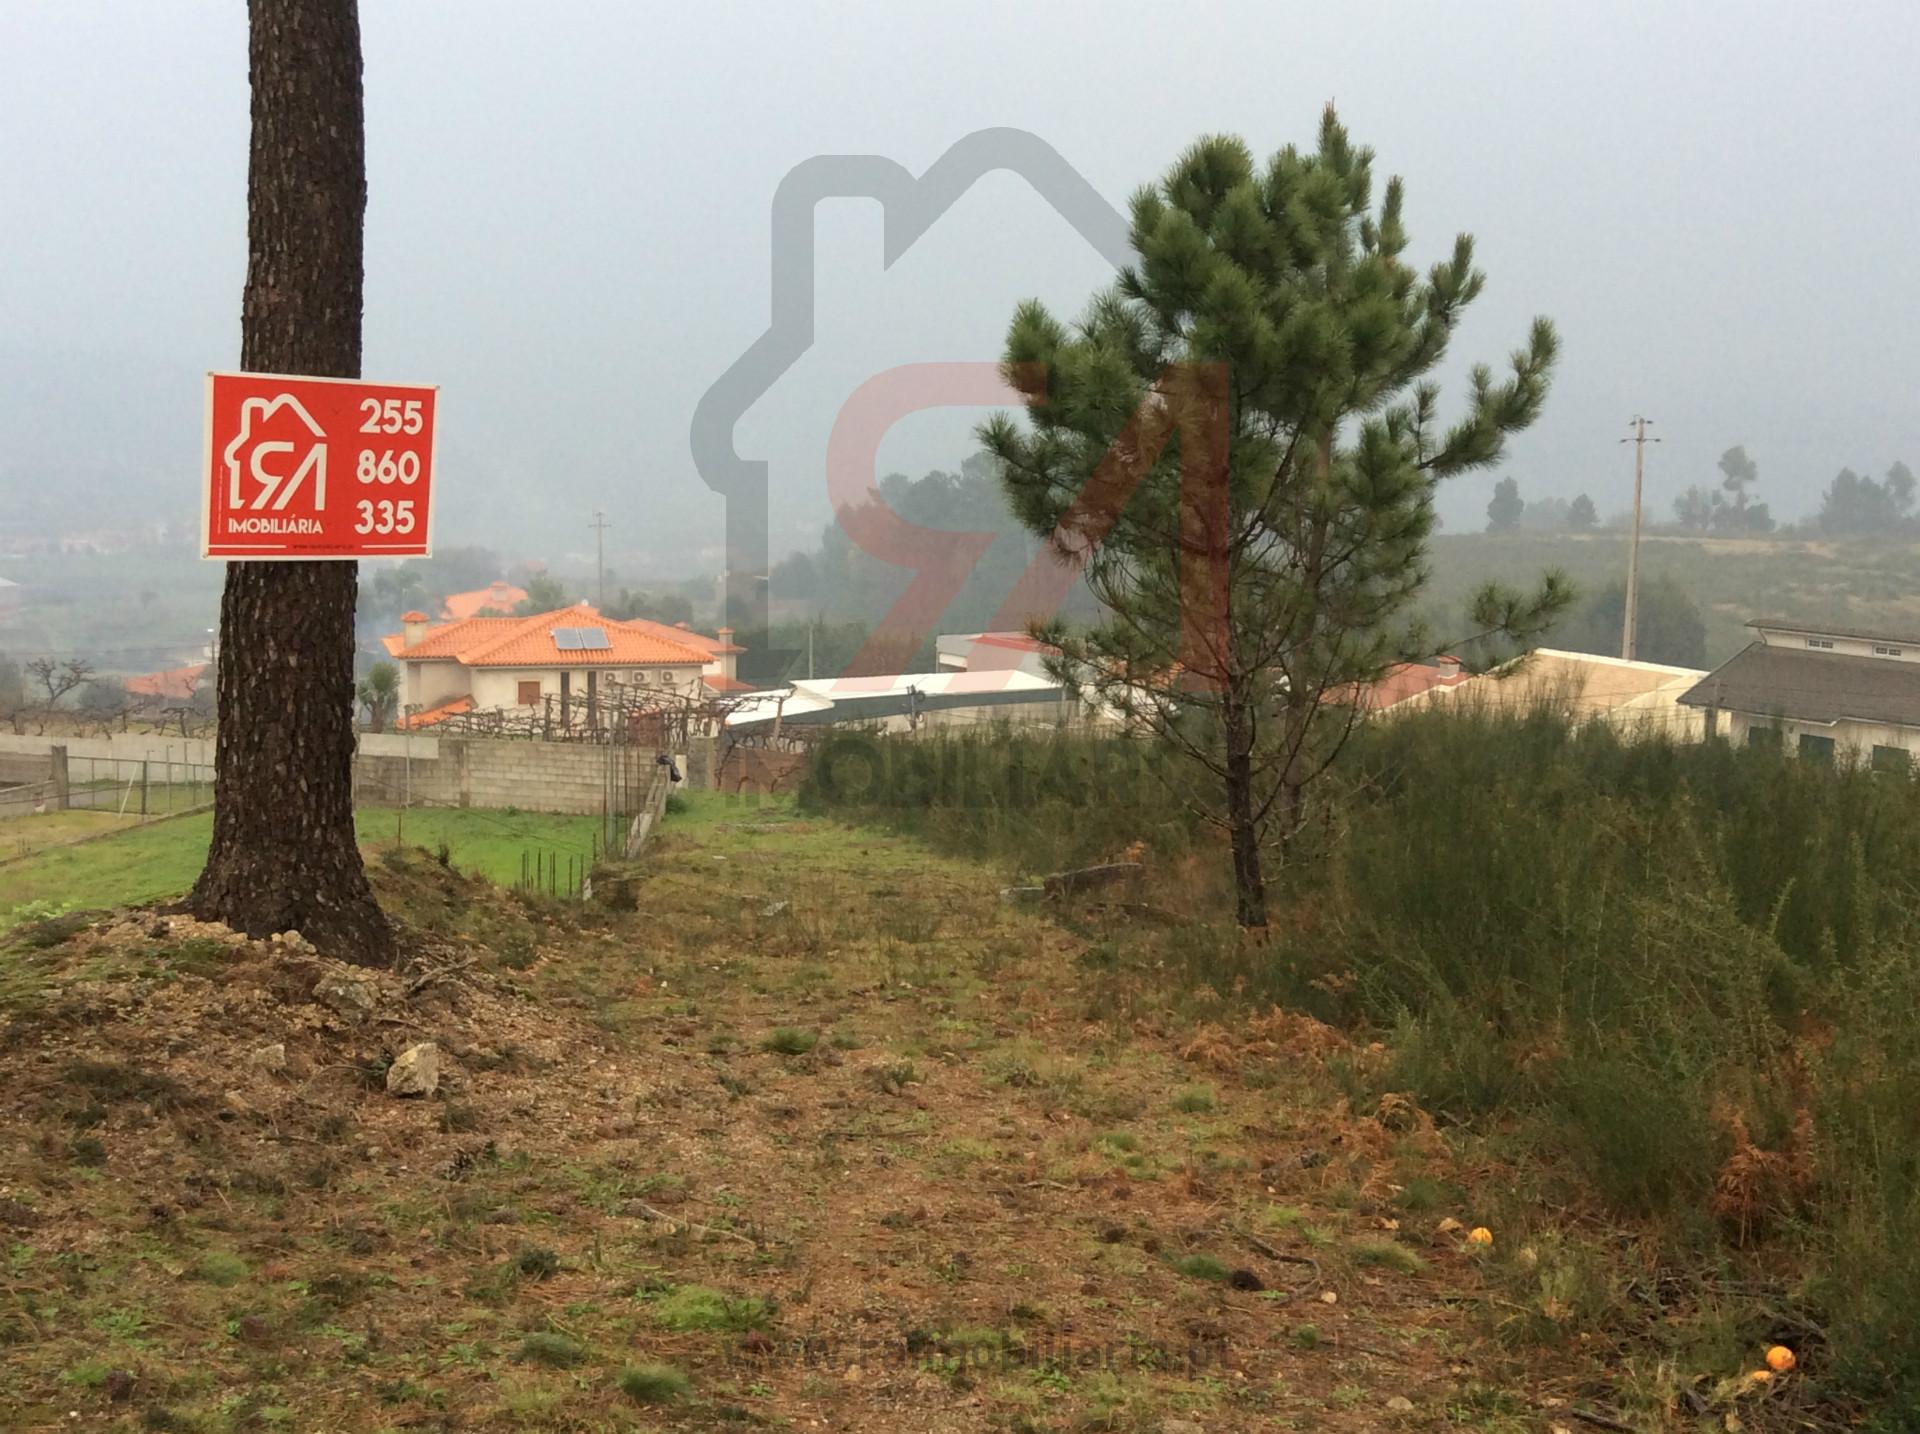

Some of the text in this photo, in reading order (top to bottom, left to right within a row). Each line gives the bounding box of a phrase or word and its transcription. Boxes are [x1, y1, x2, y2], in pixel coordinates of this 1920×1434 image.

[359, 398, 424, 435] 255
[356, 449, 421, 485] 860
[228, 514, 324, 535] IMOBILIÁRIA
[354, 499, 416, 535] 335
